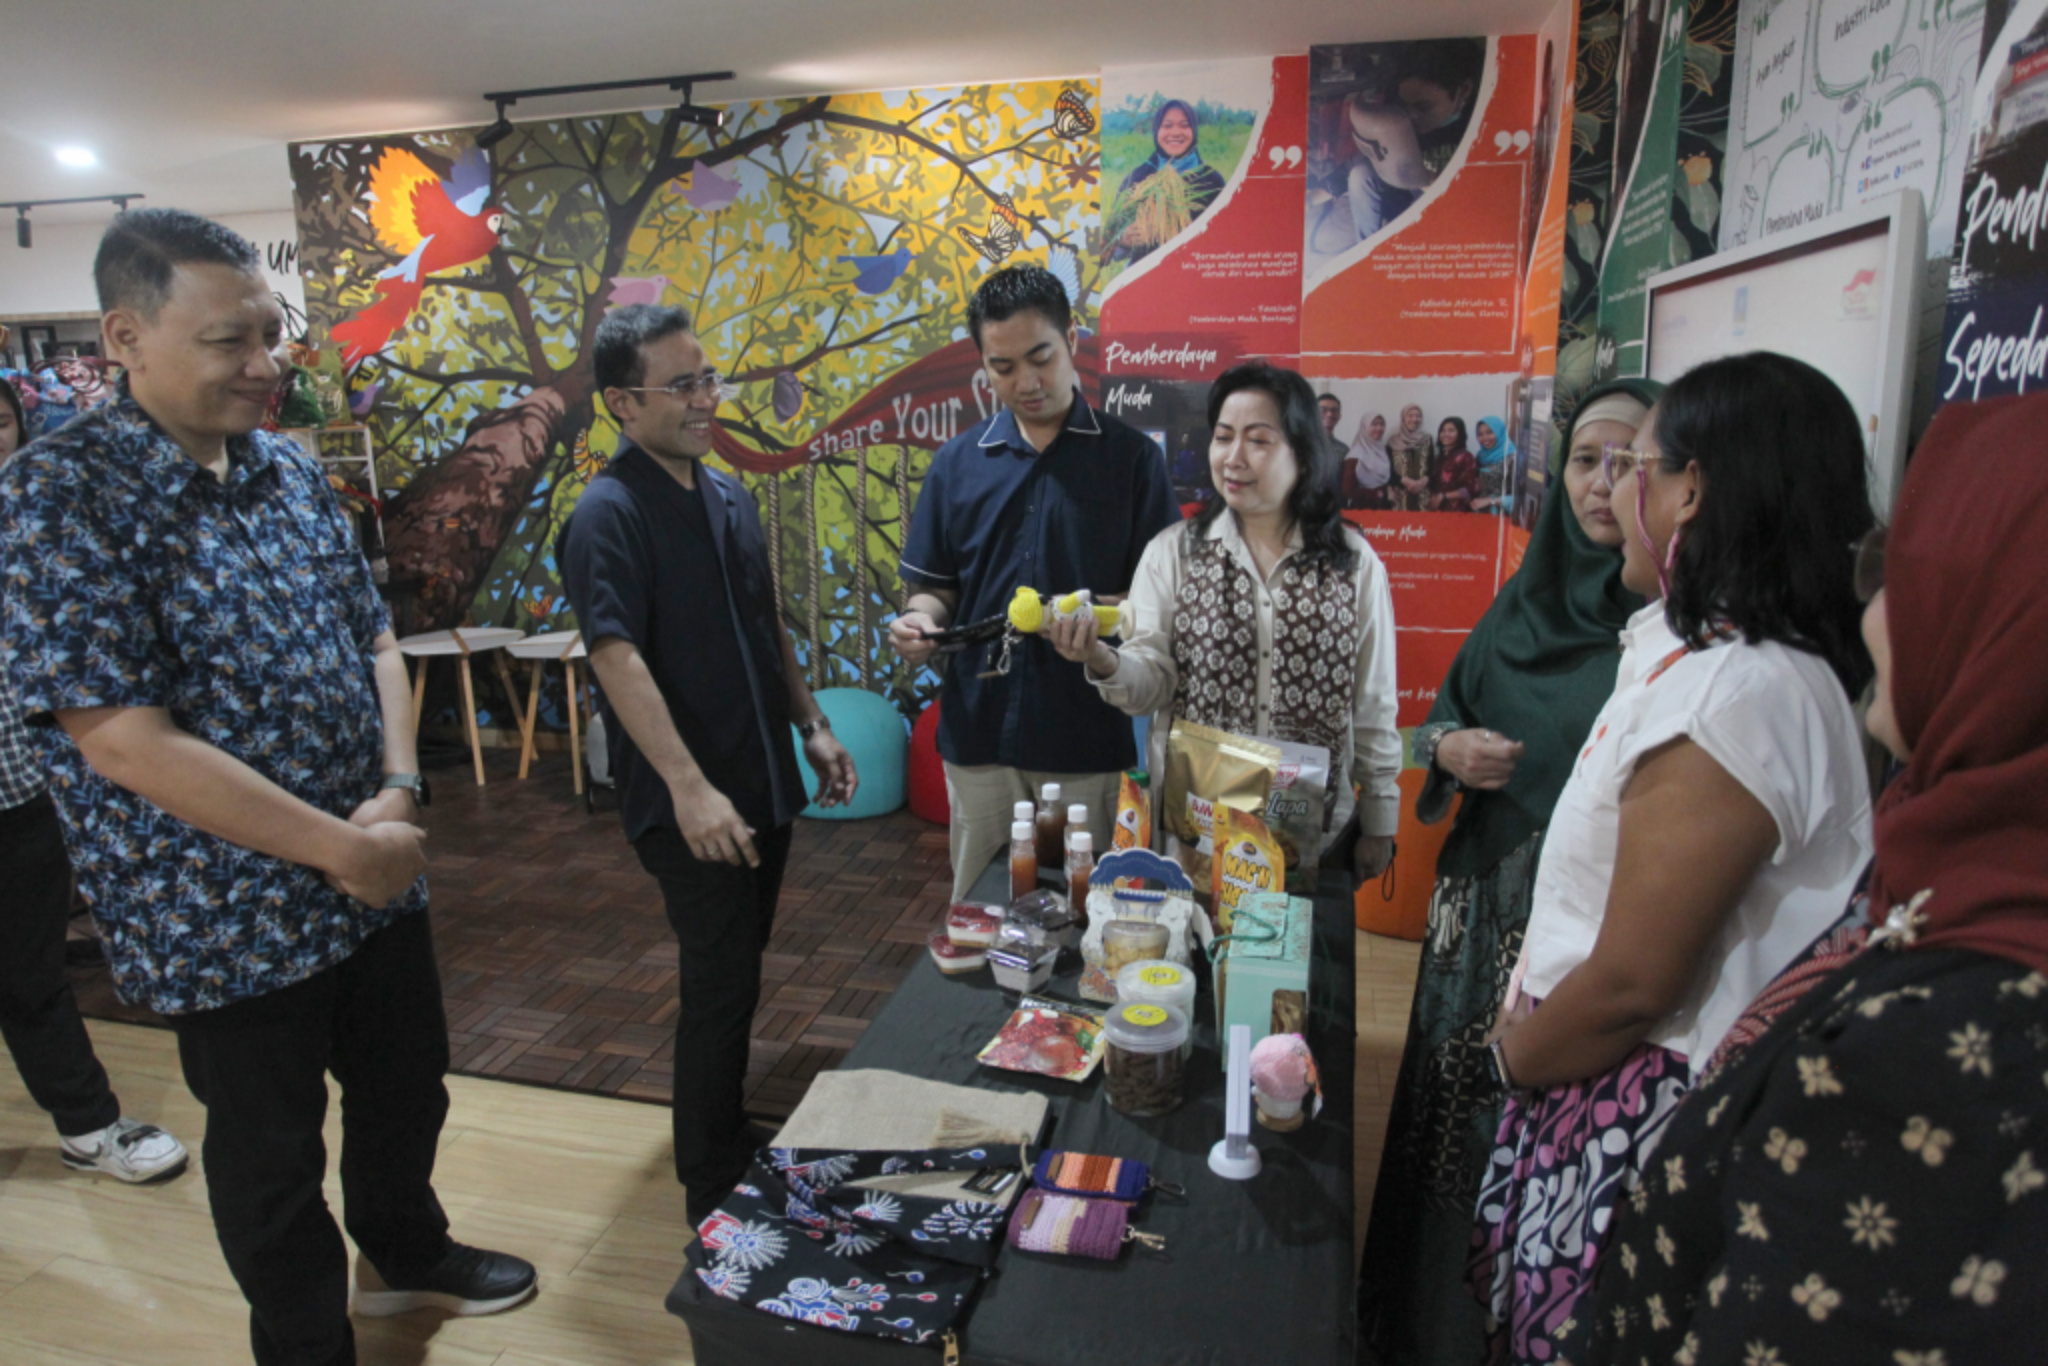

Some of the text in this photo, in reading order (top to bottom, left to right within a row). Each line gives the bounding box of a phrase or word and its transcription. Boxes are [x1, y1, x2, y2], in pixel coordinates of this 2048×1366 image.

[1105, 340, 1217, 373] Pemberdaya
[1105, 384, 1153, 416] Muda
[892, 393, 963, 442] Your
